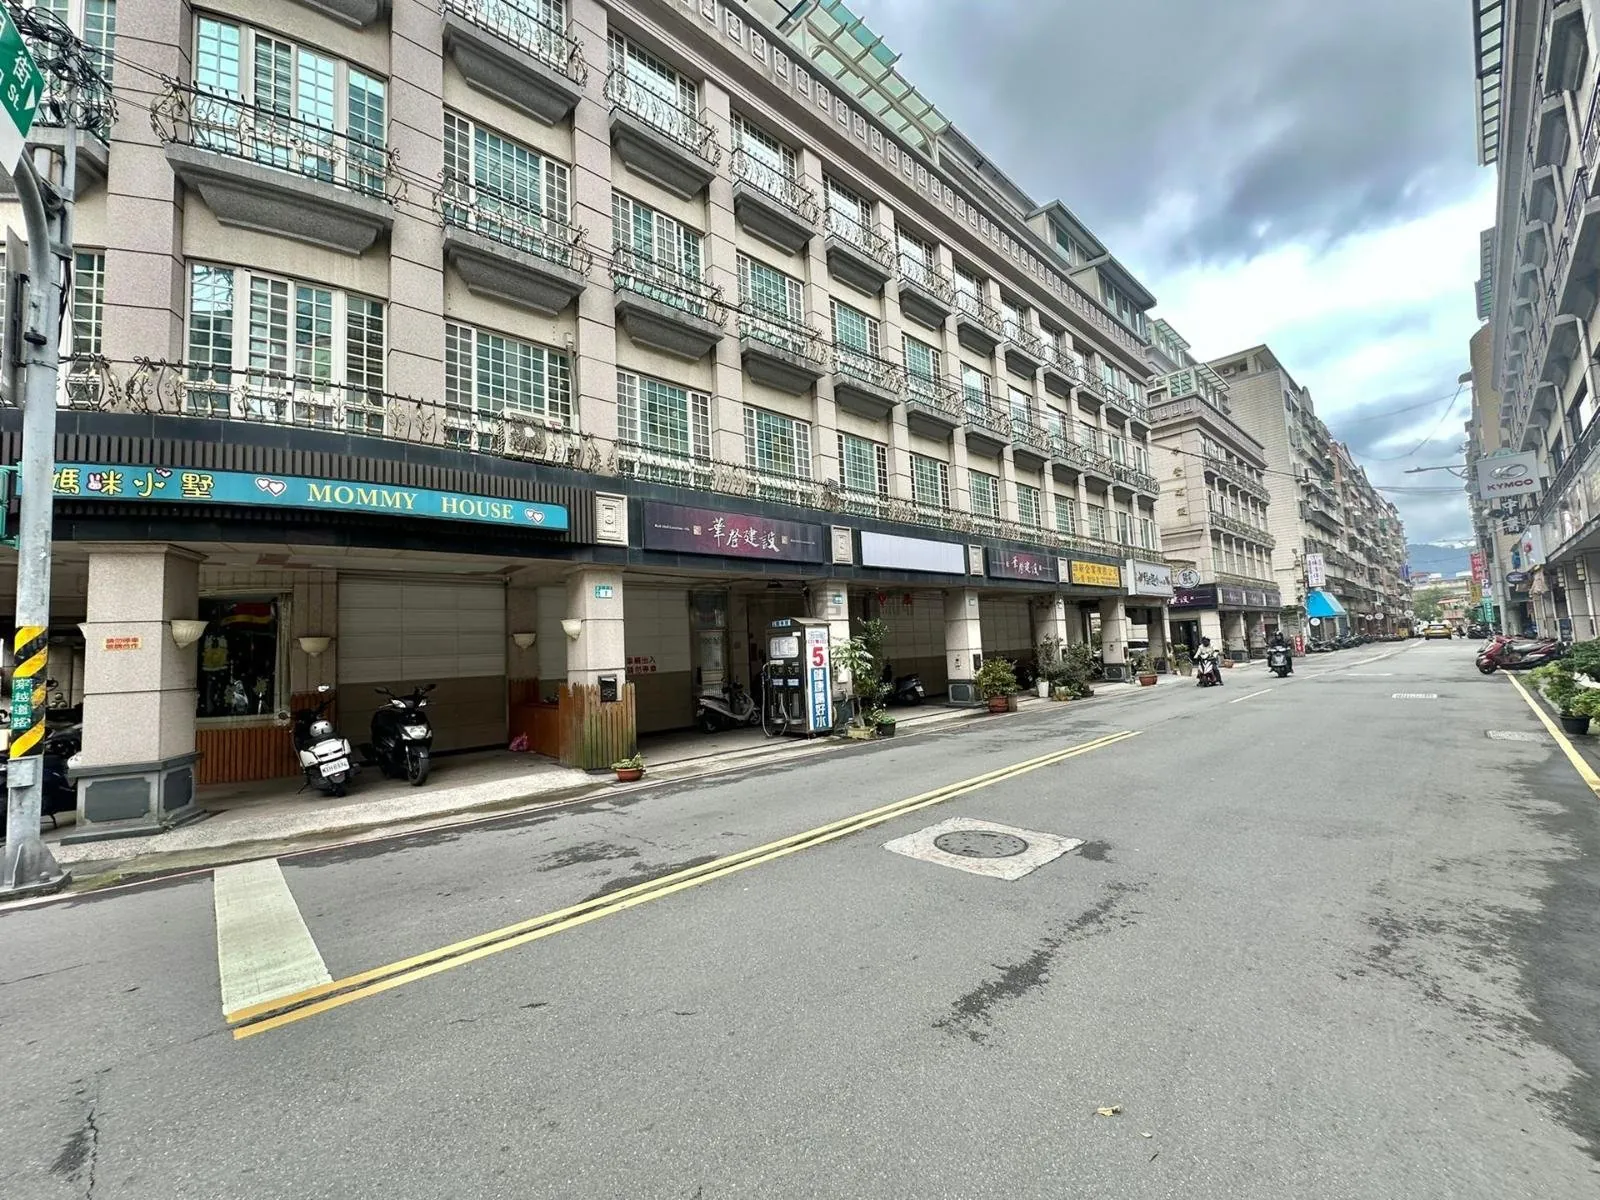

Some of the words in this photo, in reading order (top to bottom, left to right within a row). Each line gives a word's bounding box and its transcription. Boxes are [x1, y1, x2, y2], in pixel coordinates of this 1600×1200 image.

[1487, 478, 1534, 491] KYMCO
[307, 483, 419, 511] MOMMY
[441, 496, 514, 520] HOUSE
[812, 646, 824, 667] 5
